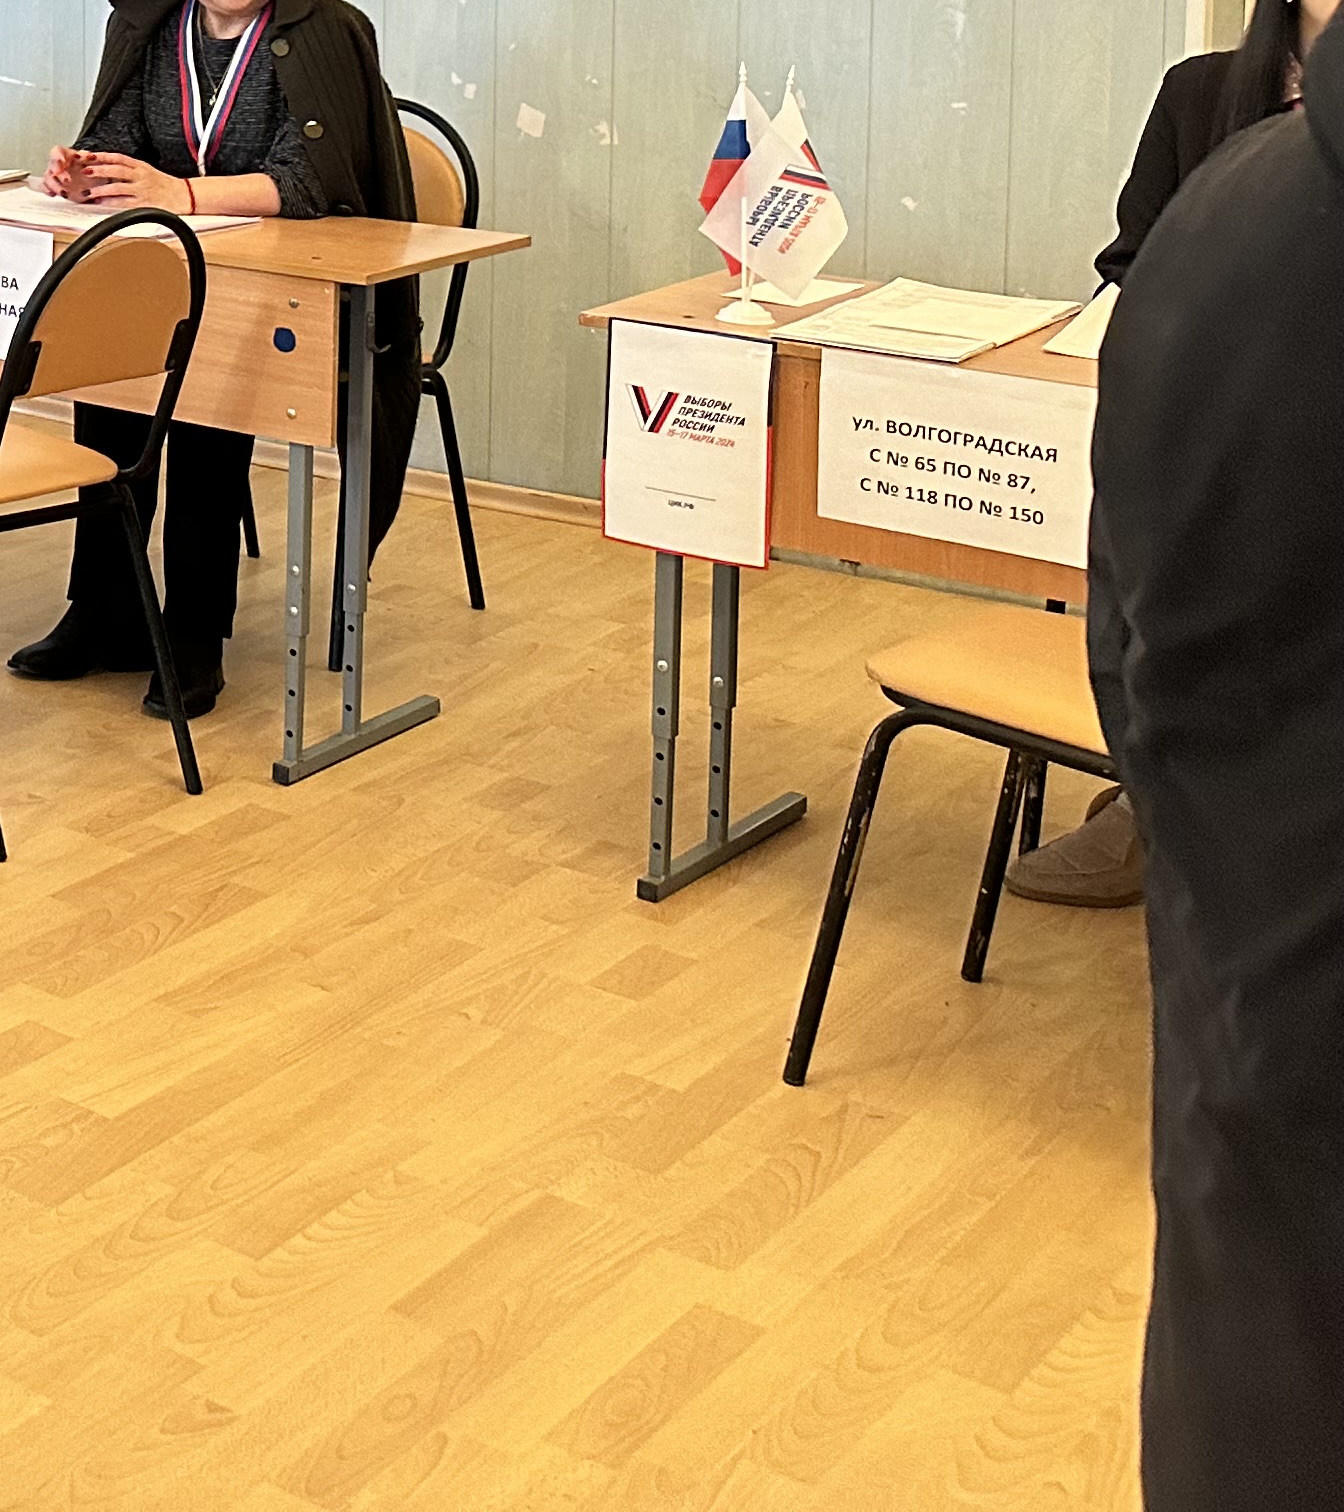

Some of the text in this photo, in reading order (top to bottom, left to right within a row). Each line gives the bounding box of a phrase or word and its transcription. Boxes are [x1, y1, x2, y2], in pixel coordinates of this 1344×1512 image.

[683, 395, 732, 411] ВЫБОРЫ
[672, 418, 716, 433] РОССИИ
[678, 406, 746, 426] ПРЕЗИДЕНТА
[689, 432, 714, 445] МАРТА
[886, 420, 1057, 463] ВОЛГОГРАДСКАЯ
[869, 448, 1037, 494] С № 65 ПО № 87,
[860, 477, 1044, 525] С № 118 ПО № 150
